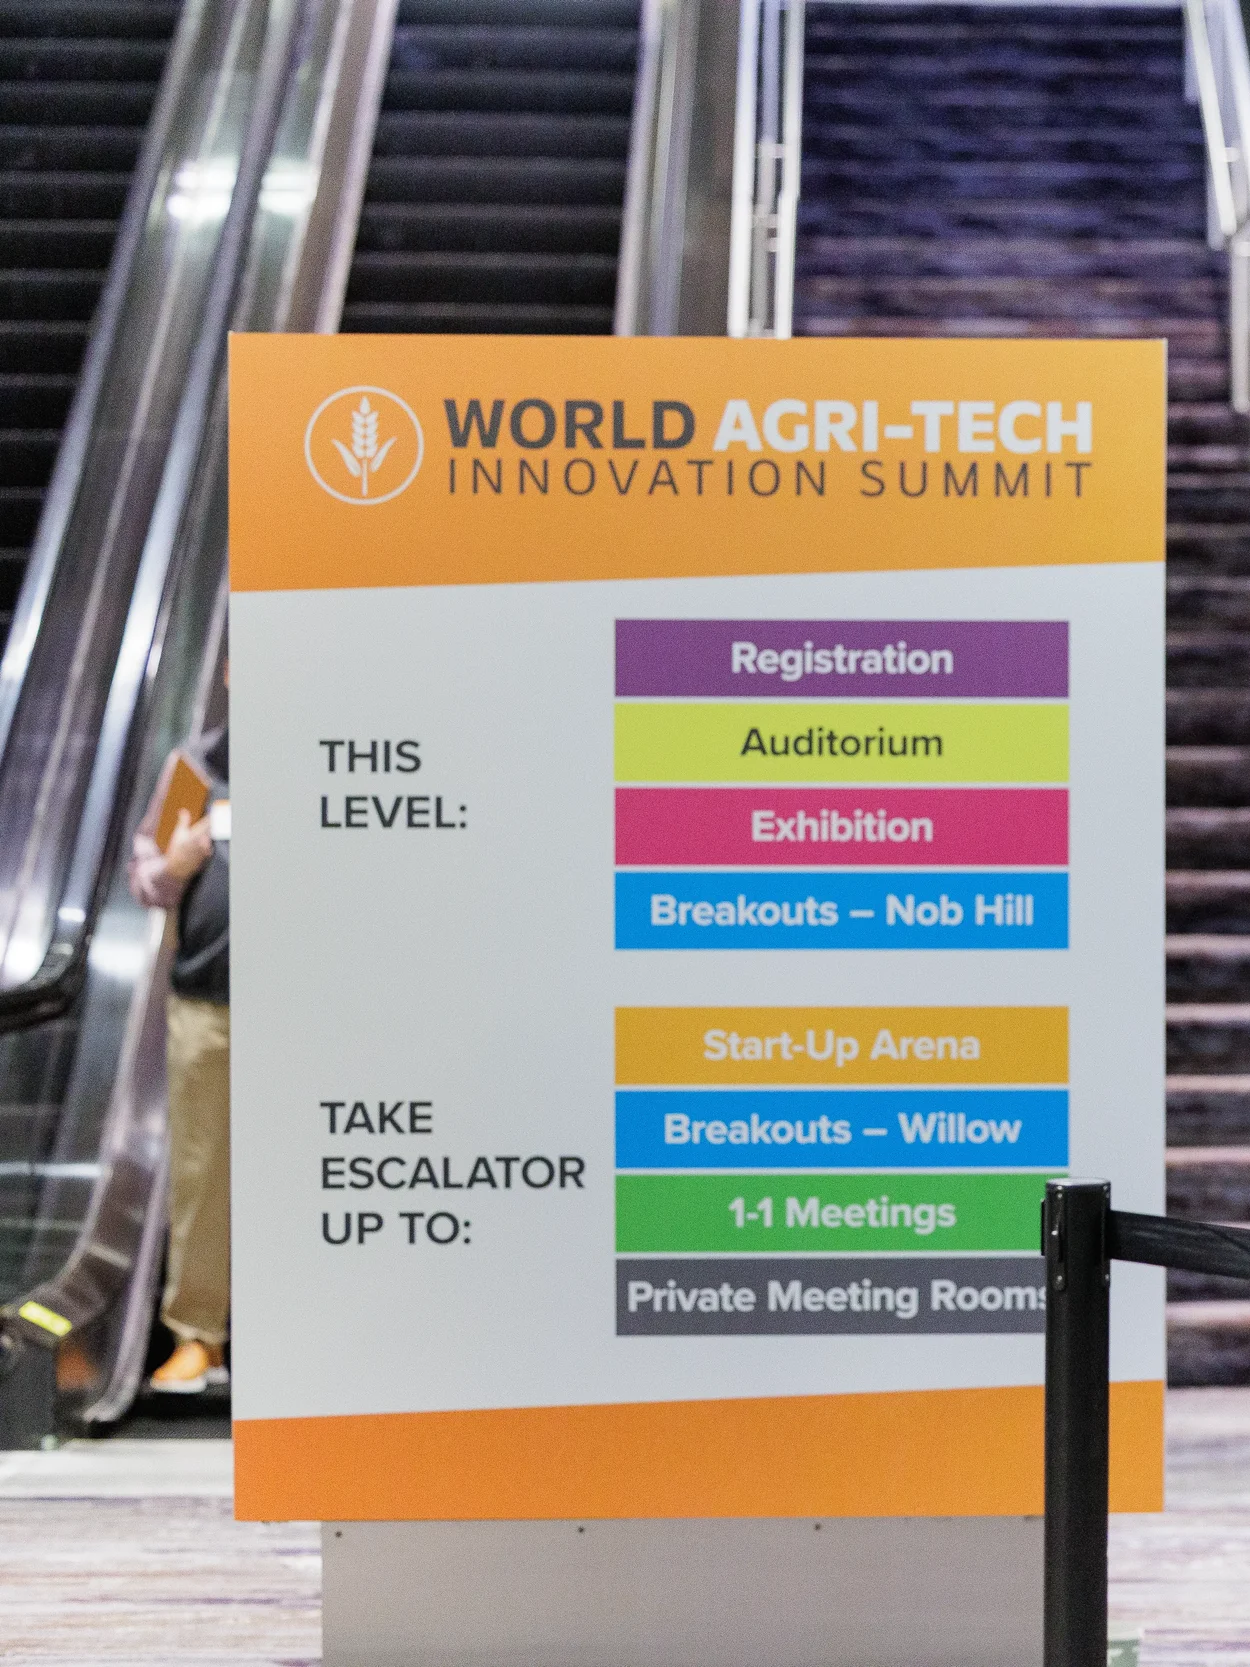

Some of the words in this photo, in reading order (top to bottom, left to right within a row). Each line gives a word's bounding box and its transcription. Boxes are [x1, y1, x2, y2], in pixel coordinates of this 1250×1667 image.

[444, 398, 695, 450] WORLD
[713, 399, 1092, 454] AGRI-TECH
[449, 459, 826, 497] INNOVATION
[860, 459, 1091, 498] SUMMIT
[731, 640, 954, 682] Registration
[319, 739, 422, 774] THIS
[740, 727, 943, 757] Auditorium
[320, 795, 467, 829] LEVEL:
[751, 809, 934, 842] Exhibition
[650, 893, 839, 927] Breakouts
[886, 894, 964, 926] Nob
[974, 893, 1034, 926] Hill
[703, 1028, 860, 1068] Start-Up
[869, 1028, 981, 1061] Arena
[319, 1100, 433, 1135] TAKE
[664, 1112, 852, 1145] Breakouts
[897, 1111, 1022, 1144] Willow
[321, 1155, 586, 1190] ESCALATOR
[321, 1211, 384, 1246] UP
[397, 1211, 471, 1245] TO:
[728, 1196, 773, 1228] 1-1
[785, 1195, 957, 1236] Meetings
[628, 1279, 756, 1313] Private
[768, 1278, 919, 1319] Meeting
